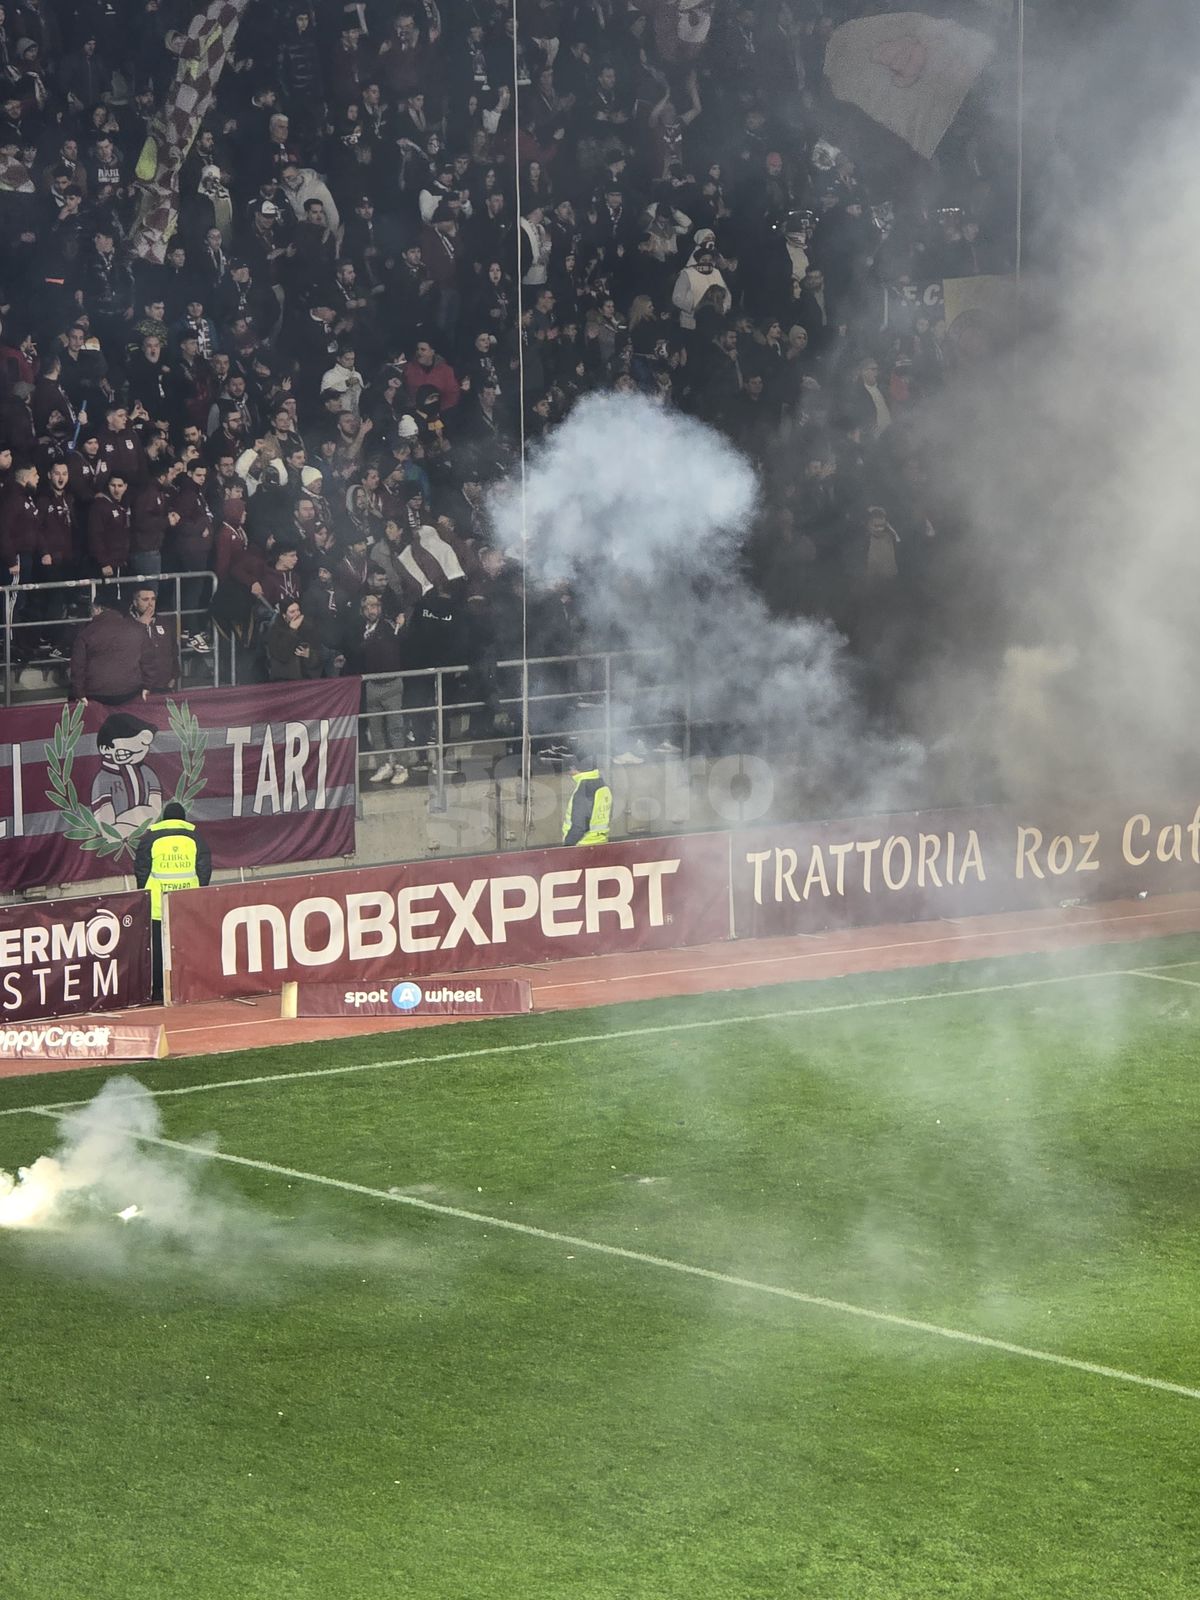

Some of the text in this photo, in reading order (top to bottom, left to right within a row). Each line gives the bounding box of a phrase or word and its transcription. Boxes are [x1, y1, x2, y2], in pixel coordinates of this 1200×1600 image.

[226, 720, 329, 816] TARI
[159, 861, 191, 869] GUARD
[161, 853, 190, 861] LIBRA
[746, 830, 986, 904] TRATTORIA
[1015, 826, 1100, 880] Roz
[222, 859, 681, 977] MOBEXPERT
[3, 959, 119, 1010] STEM
[344, 987, 484, 1008] spot A wheel
